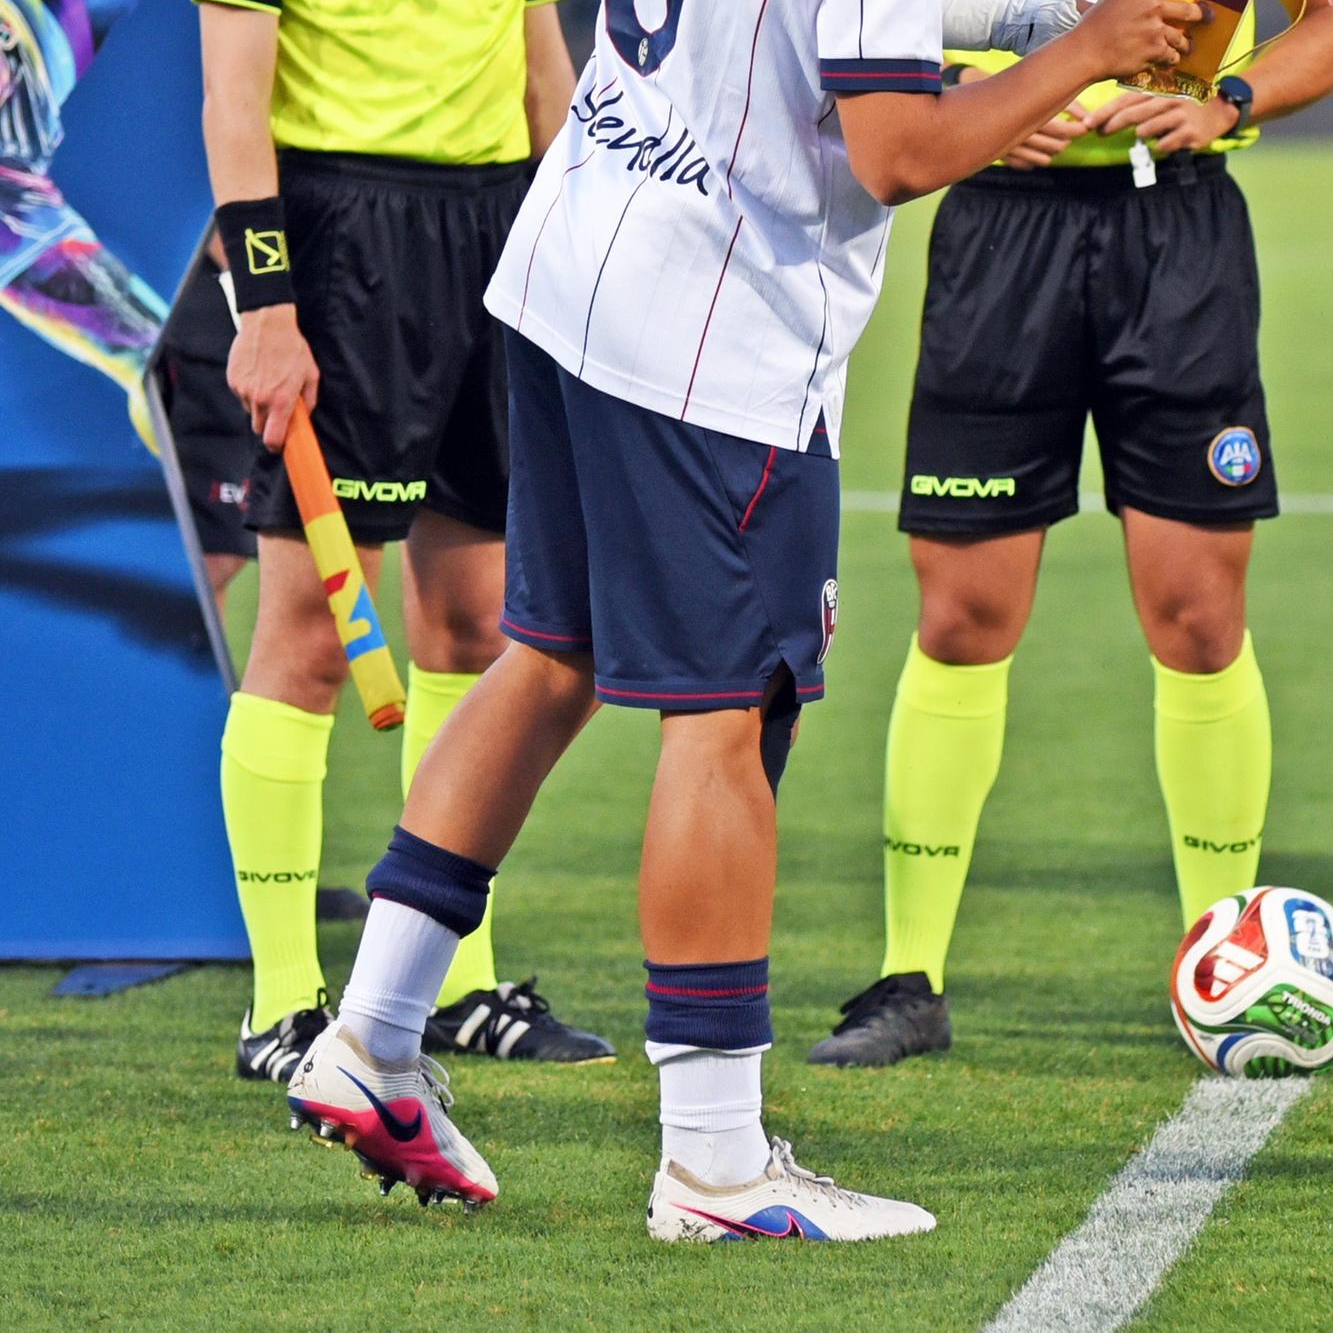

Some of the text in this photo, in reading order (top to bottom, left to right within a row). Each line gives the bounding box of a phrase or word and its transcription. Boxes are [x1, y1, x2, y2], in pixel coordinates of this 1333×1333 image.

[332, 477, 427, 503] GIVOVA
[910, 474, 1016, 499] GIVOVA
[1283, 990, 1331, 1026] TRIONDA
